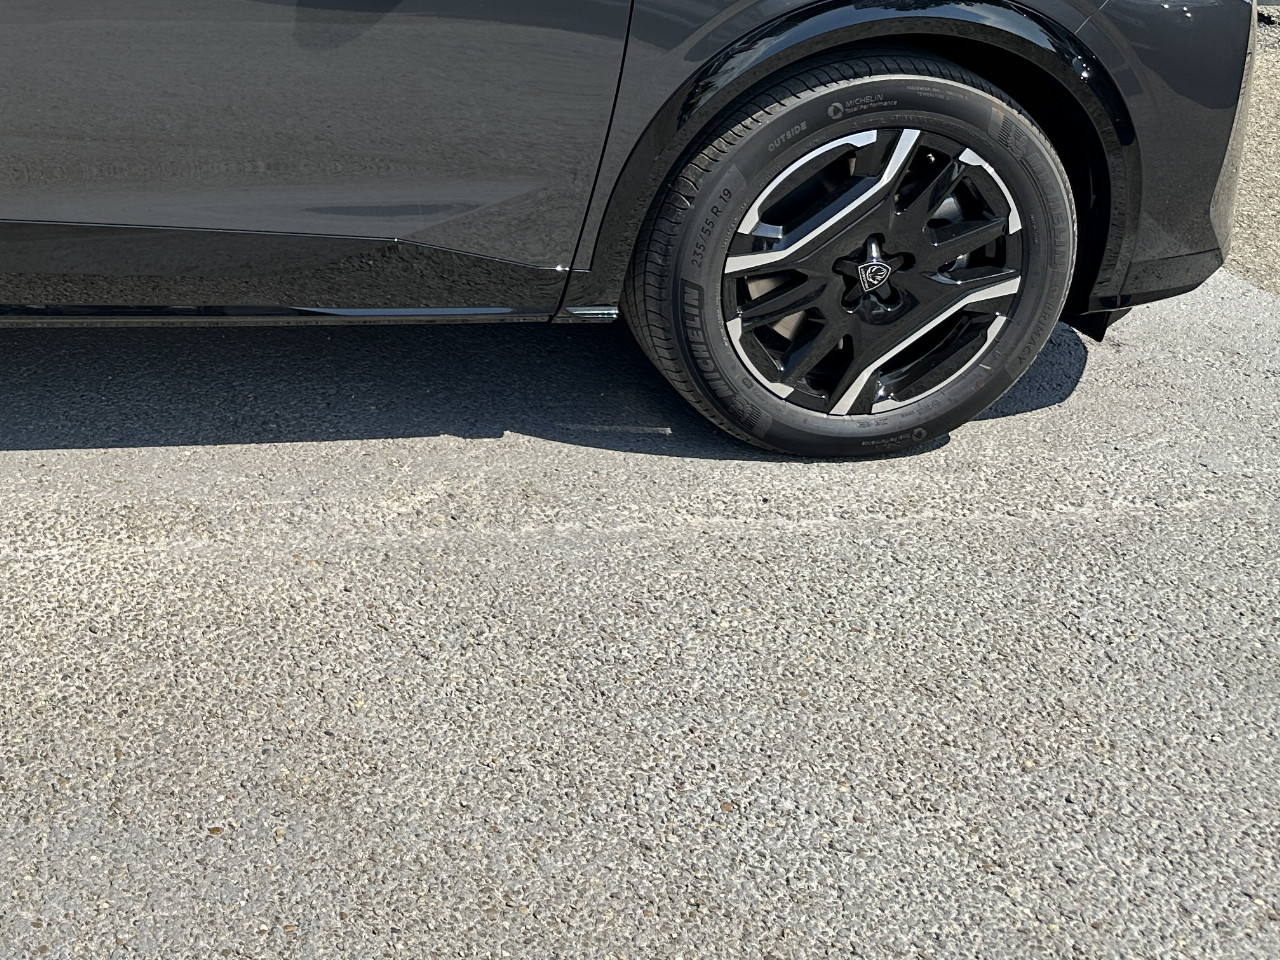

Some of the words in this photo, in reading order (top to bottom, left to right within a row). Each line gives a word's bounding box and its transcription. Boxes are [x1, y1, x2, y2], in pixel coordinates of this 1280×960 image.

[767, 120, 808, 152] OUTSIDE
[845, 93, 885, 106] MICHELIN
[691, 217, 715, 268] 235/55
[710, 205, 723, 218] R
[719, 187, 732, 204] 19
[1024, 151, 1068, 270] MICHELIN
[683, 286, 734, 399] MICHELIN
